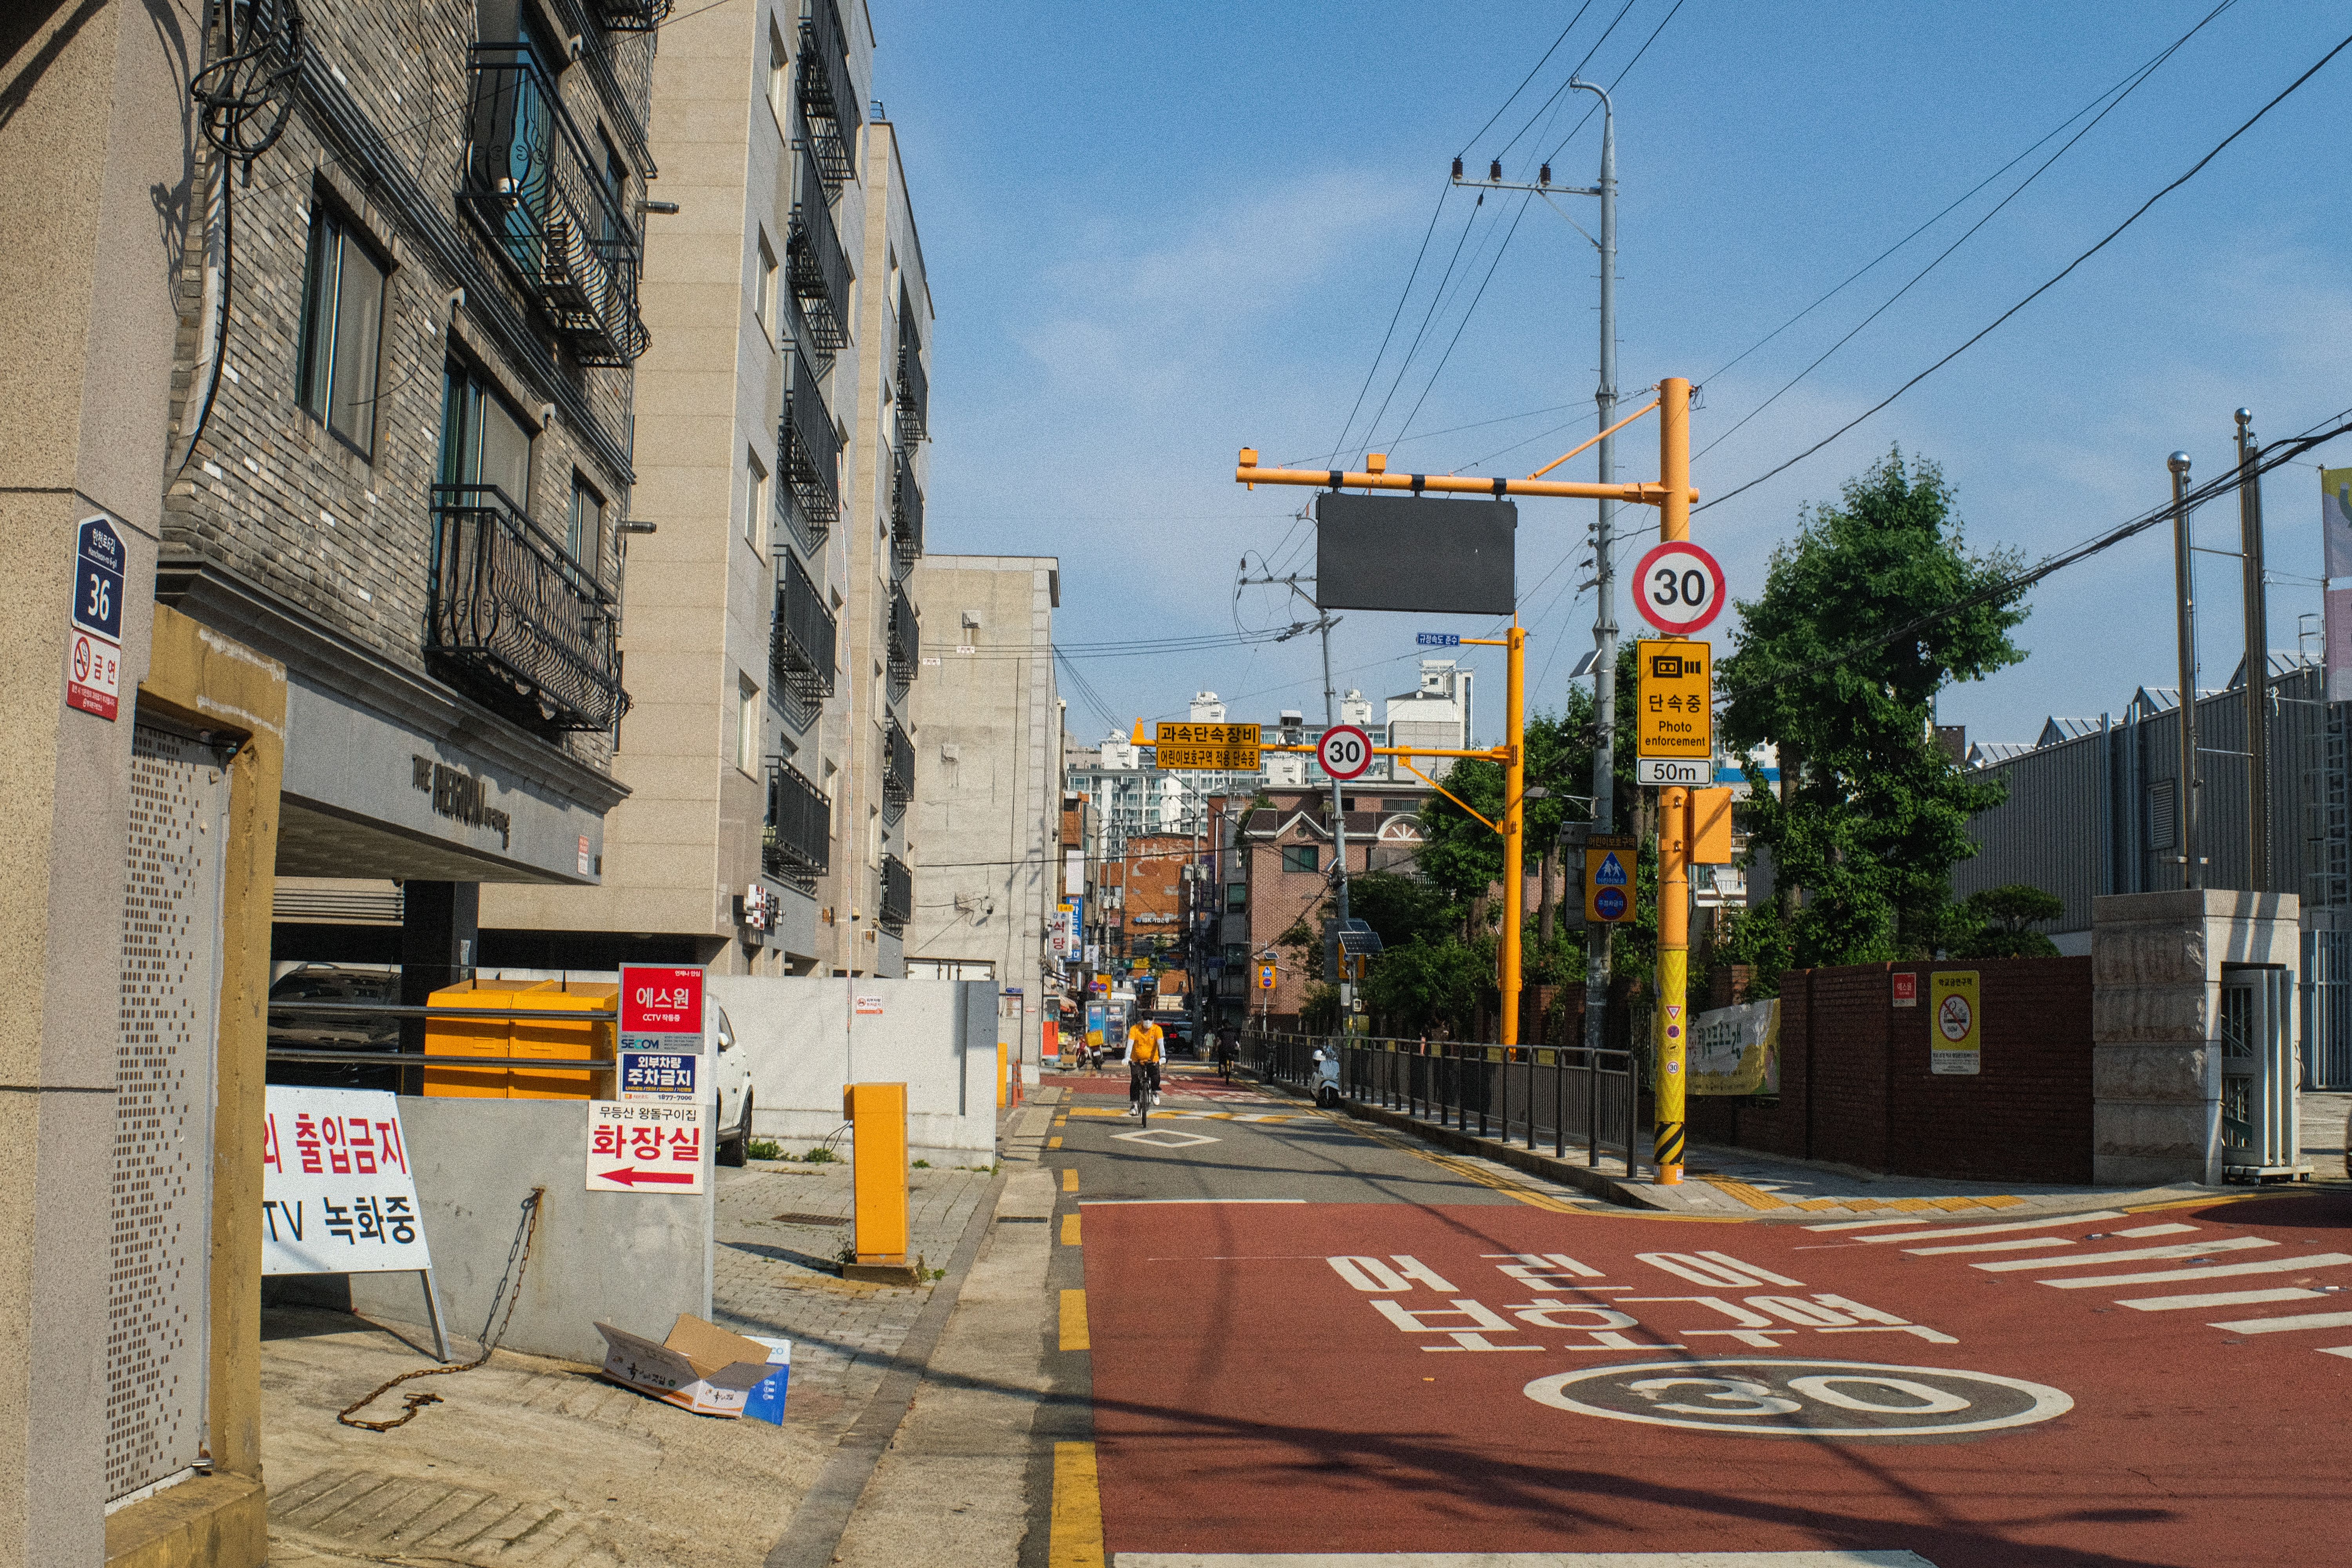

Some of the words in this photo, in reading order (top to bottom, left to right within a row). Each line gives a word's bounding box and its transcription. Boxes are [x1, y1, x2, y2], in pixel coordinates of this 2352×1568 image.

[93, 528, 115, 555] 한천로6길
[88, 573, 110, 621] 36
[1653, 569, 1705, 606] 30
[1420, 635, 1443, 644] 규정속도
[1445, 636, 1457, 645] 준수
[94, 654, 115, 685] 금연
[1649, 694, 1701, 713] 단속중
[1161, 726, 1257, 743] 과속단속장비
[1659, 720, 1691, 732] Photo
[1645, 735, 1705, 746] enforcement
[1161, 747, 1212, 766] 어린이보호구역
[1216, 748, 1230, 766] 적용
[1233, 748, 1255, 767] 단속중
[1329, 741, 1360, 763] 30
[1653, 763, 1696, 780] 50m
[1588, 837, 1635, 847] 어린이보호구역
[1053, 920, 1065, 950] 식당
[636, 987, 689, 1010] 에스원
[642, 1014, 661, 1022] CCTV
[662, 1014, 681, 1022] 작동중
[621, 1039, 659, 1049] SECOM
[638, 1056, 681, 1069] 외부차량
[628, 1069, 691, 1086] 주차금지
[599, 1107, 634, 1119] 무등산
[639, 1107, 696, 1121] 왕돌구이집
[296, 1113, 407, 1174] 출입금지
[592, 1124, 699, 1161] 화장실
[324, 1196, 416, 1245] 녹화중
[1326, 1250, 1806, 1292] 어린이
[1370, 1294, 1960, 1352] 보호구역
[1623, 1375, 1971, 1417] 30
